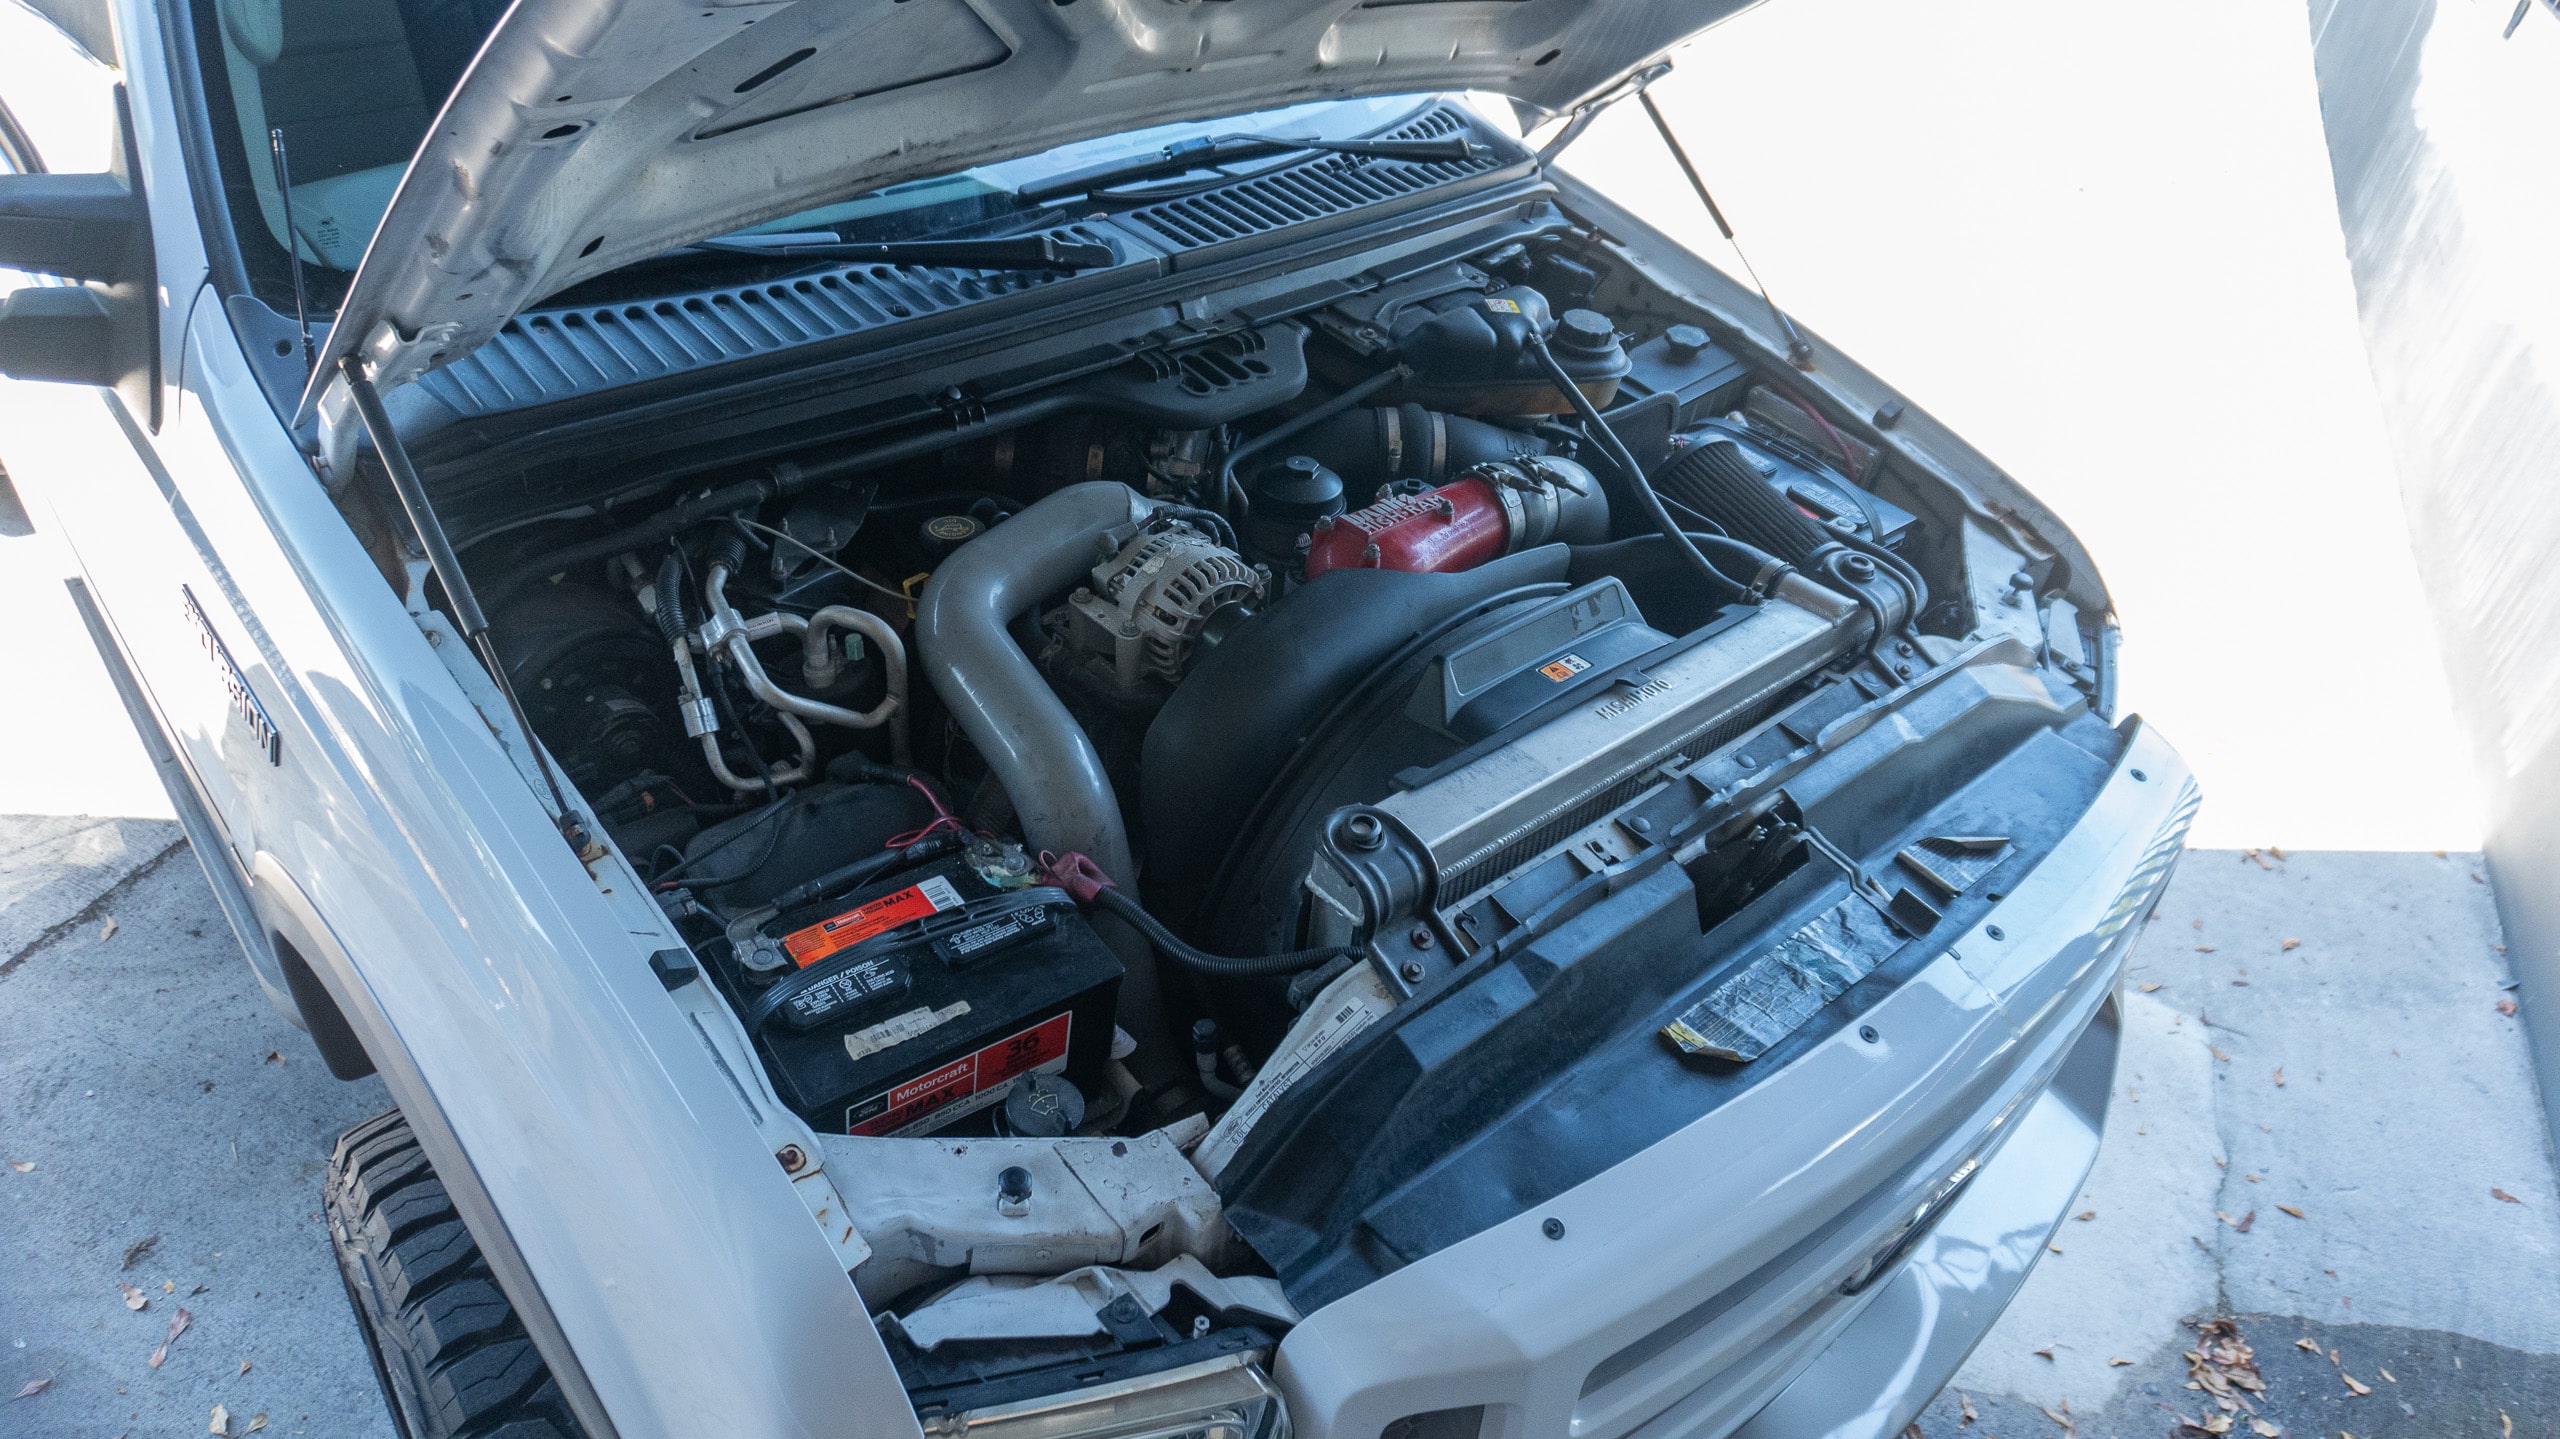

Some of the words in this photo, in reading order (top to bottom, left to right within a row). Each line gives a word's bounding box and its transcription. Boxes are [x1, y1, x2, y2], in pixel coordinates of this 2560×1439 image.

[1595, 679, 1673, 720] MISHIMOTO
[884, 891, 914, 908] MAX
[845, 960, 874, 975] POISON
[1007, 1032, 1040, 1054] 36
[896, 1063, 969, 1101] Motorcraft
[905, 1085, 954, 1117] MAX
